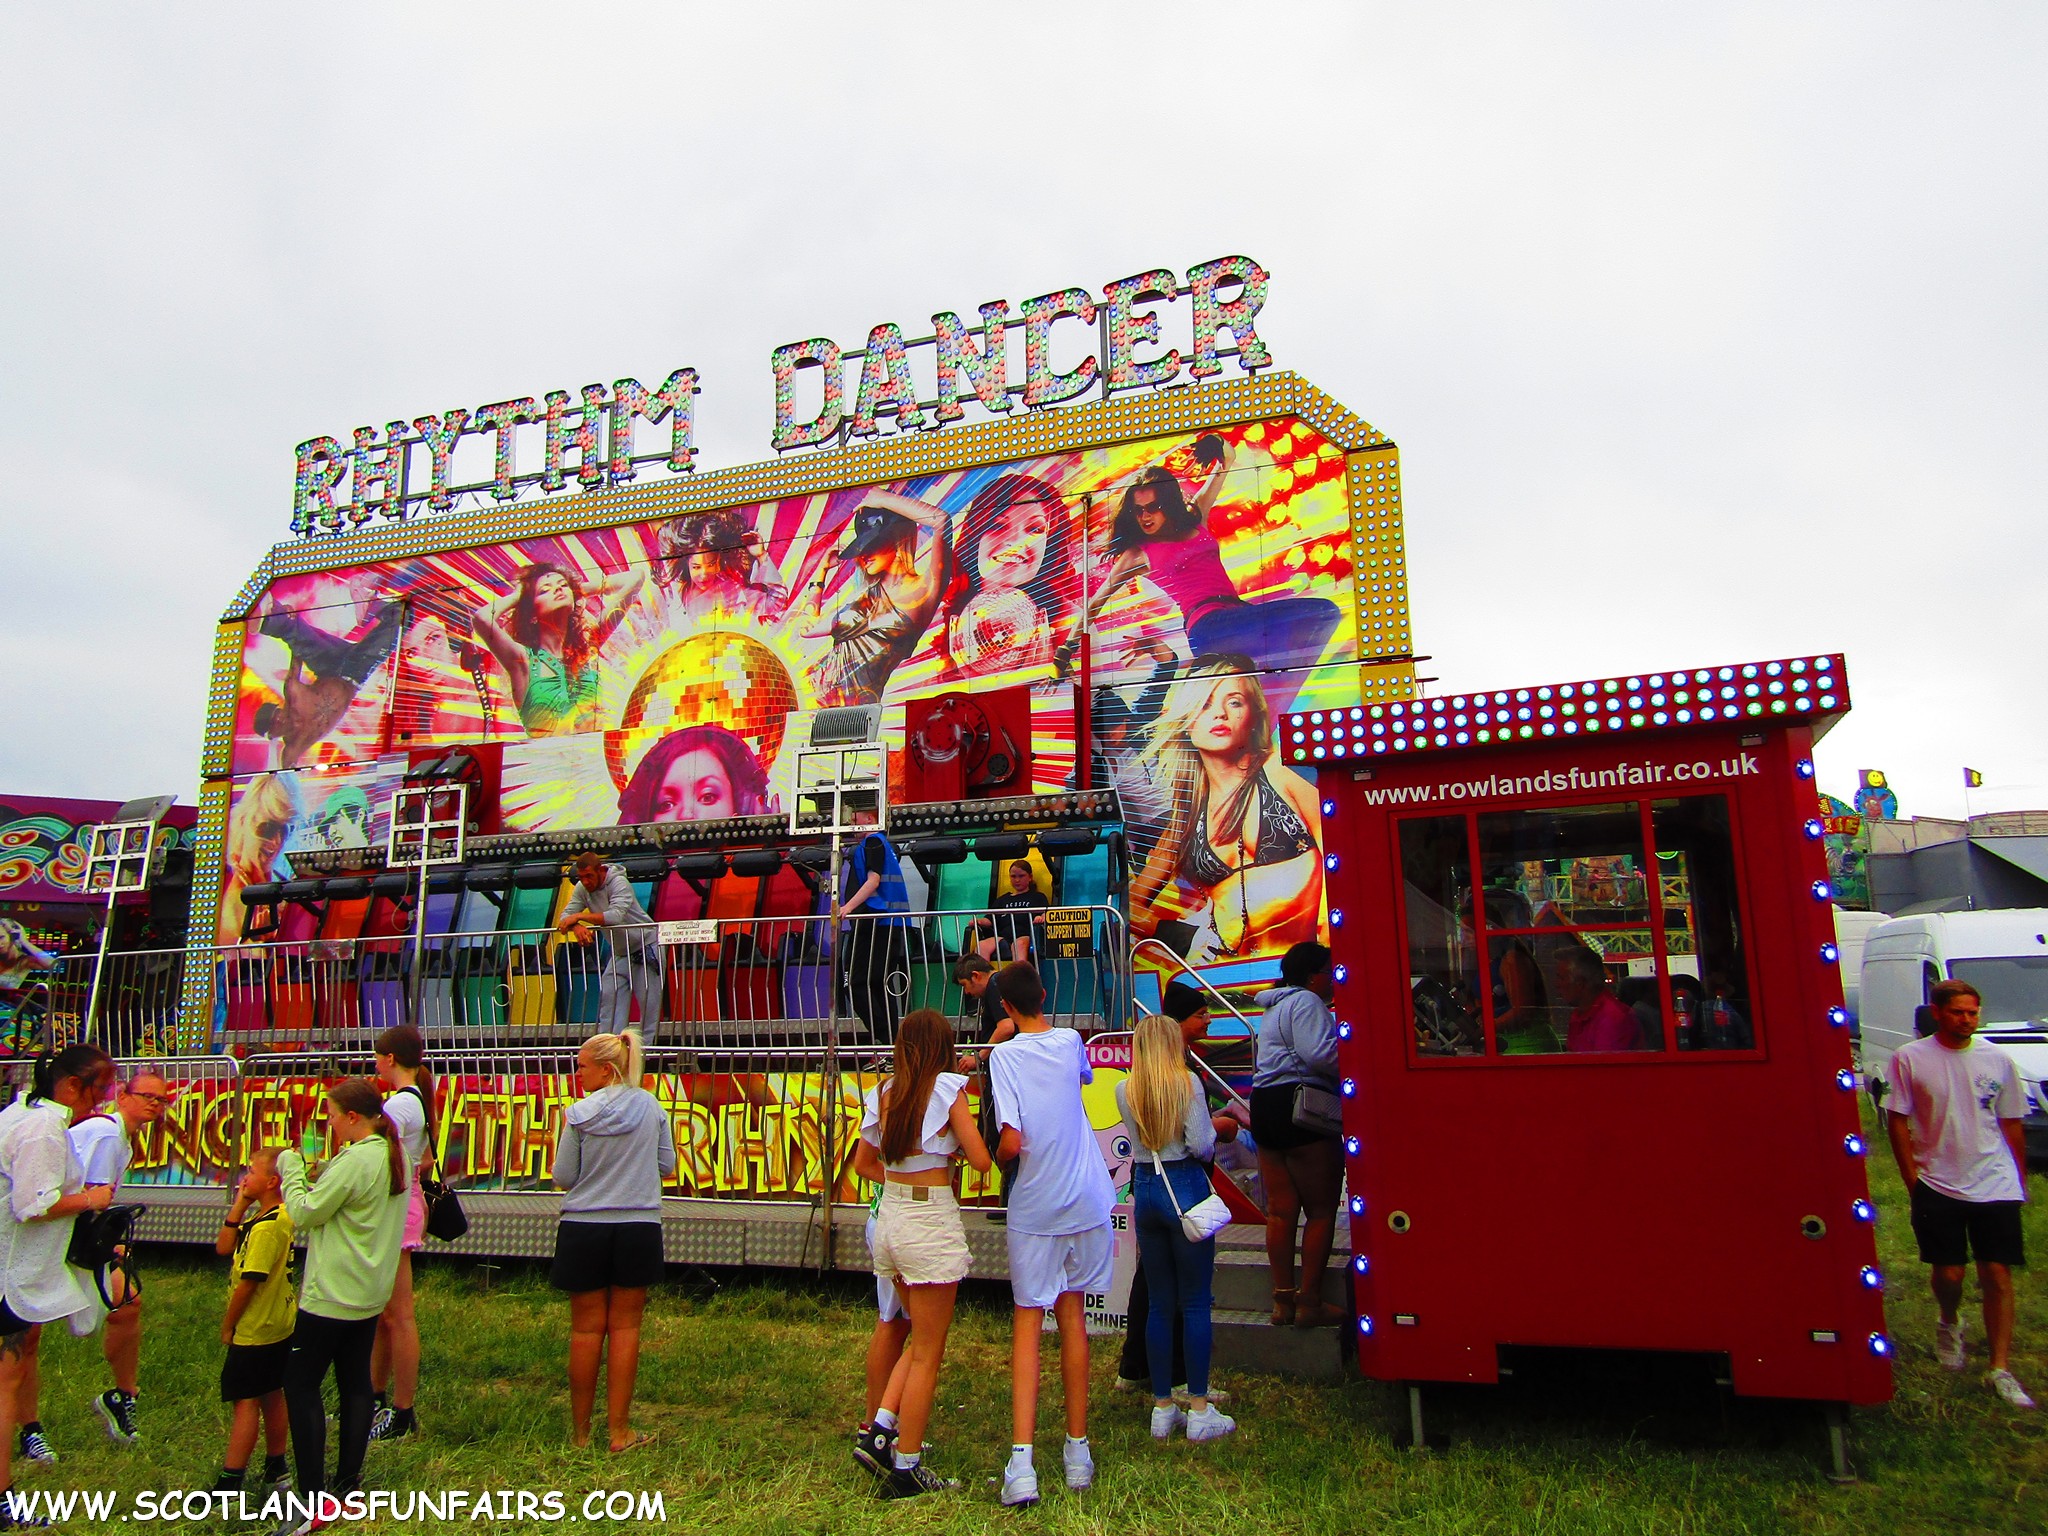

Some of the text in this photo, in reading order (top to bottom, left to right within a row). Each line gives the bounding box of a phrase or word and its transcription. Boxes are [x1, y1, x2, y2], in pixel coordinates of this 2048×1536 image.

[291, 254, 1272, 534] RHYTHM DANCER
[1364, 752, 1759, 806] www.rowlandsfunfair.co.uk
[1048, 910, 1089, 922] CAUTION
[1046, 923, 1091, 939] SLIPPERY WHEN
[1062, 943, 1076, 957] WET
[453, 1093, 572, 1181] TH
[1085, 1293, 1105, 1309] DE
[1084, 1311, 1128, 1329] CHINE
